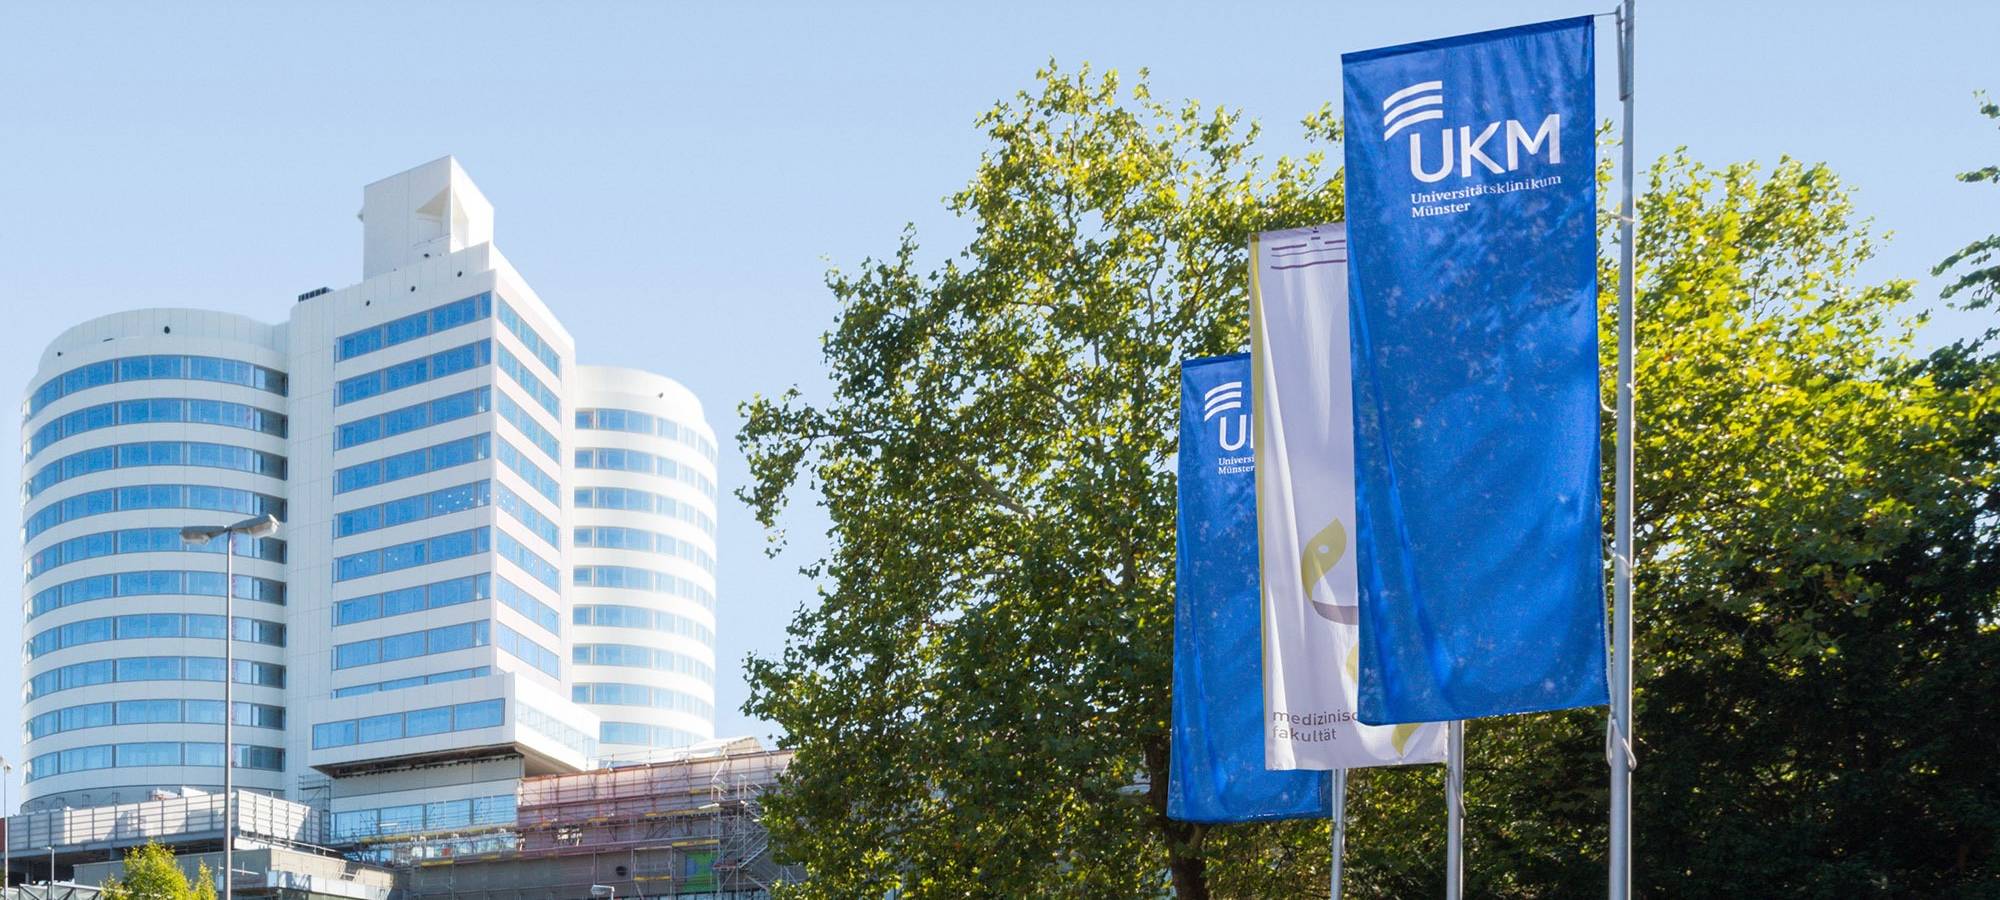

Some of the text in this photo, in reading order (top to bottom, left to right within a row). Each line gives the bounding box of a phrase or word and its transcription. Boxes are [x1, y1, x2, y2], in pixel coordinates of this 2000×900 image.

[1410, 114, 1560, 183] UKM
[1411, 175, 1561, 204] Universitätsklinikum
[1411, 202, 1471, 218] Münster
[1220, 414, 1254, 451] U
[1218, 465, 1255, 475] Münster
[1273, 725, 1336, 742] fakultät
